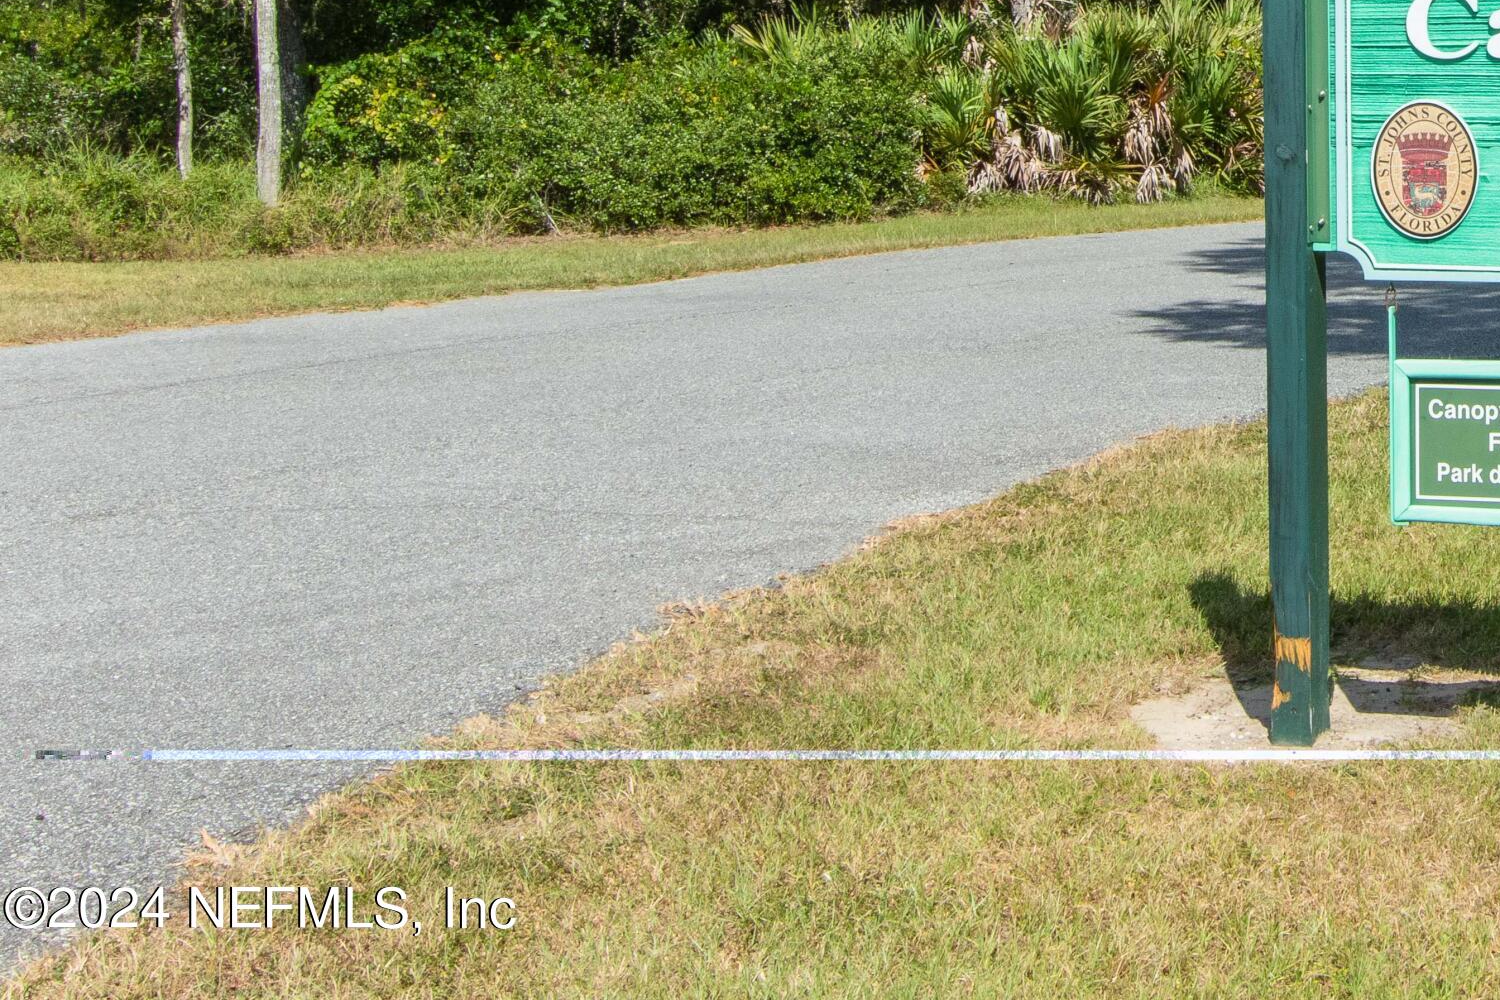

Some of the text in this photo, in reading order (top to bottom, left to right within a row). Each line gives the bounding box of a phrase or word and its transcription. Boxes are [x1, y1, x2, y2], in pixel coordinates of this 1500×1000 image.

[1383, 107, 1430, 148] JOHNS
[1436, 112, 1473, 179] COUNTY
[1390, 204, 1462, 232] FLORIDA
[1437, 462, 1484, 484] Park
